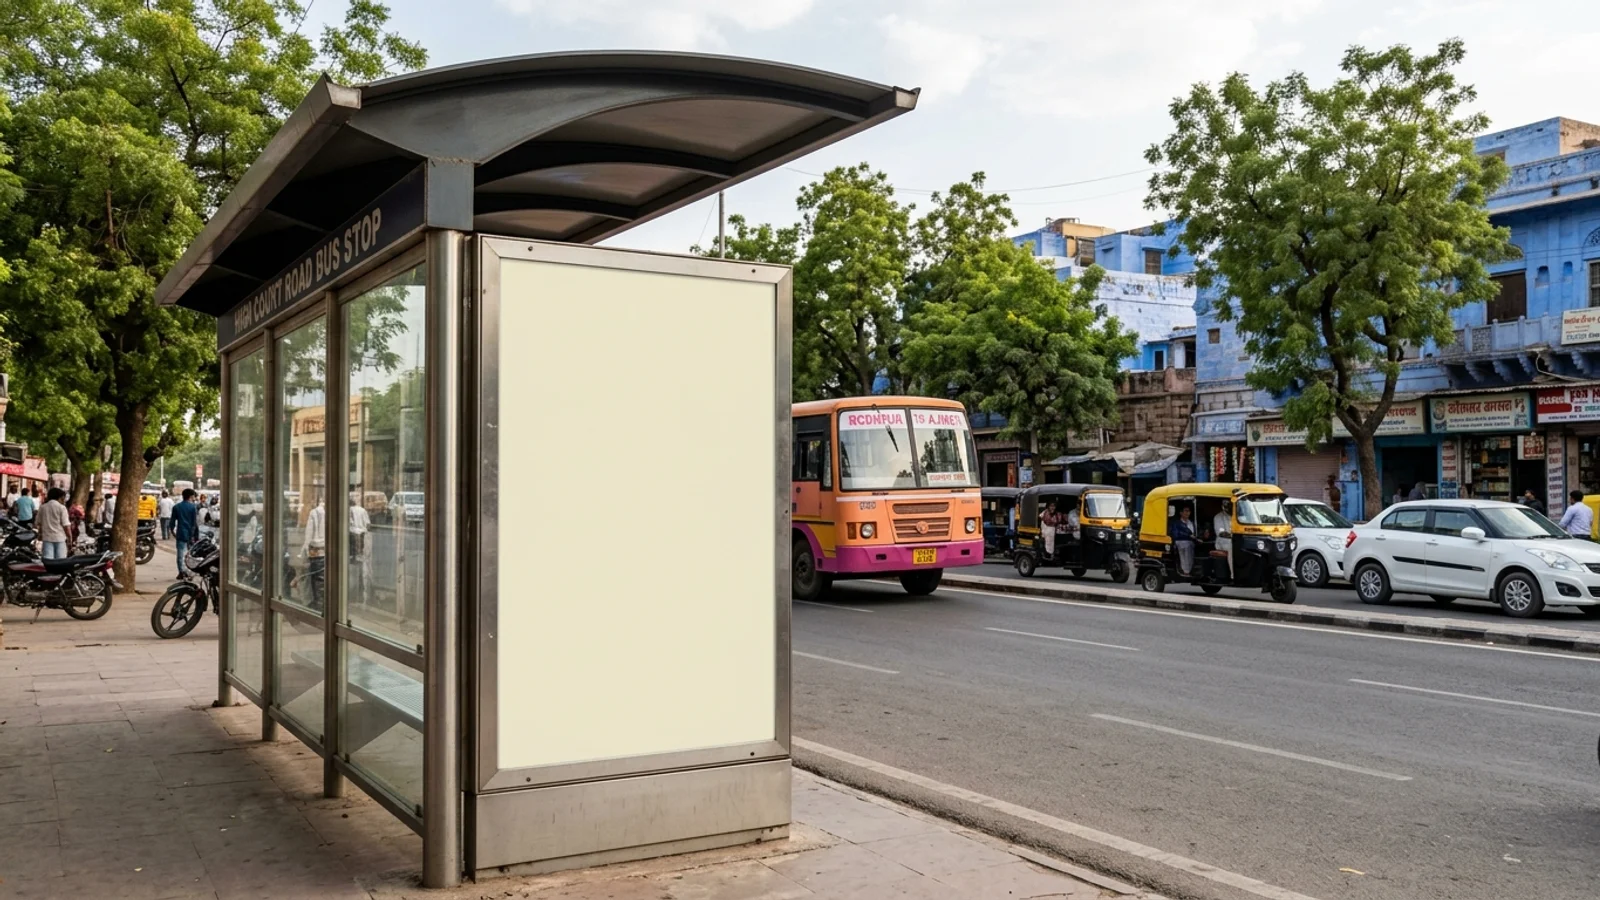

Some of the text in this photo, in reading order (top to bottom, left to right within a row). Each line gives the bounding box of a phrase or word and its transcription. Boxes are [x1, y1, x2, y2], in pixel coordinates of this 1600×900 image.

[285, 257, 313, 302] ROAD
[316, 237, 340, 282] BUS
[344, 208, 382, 264] STOP
